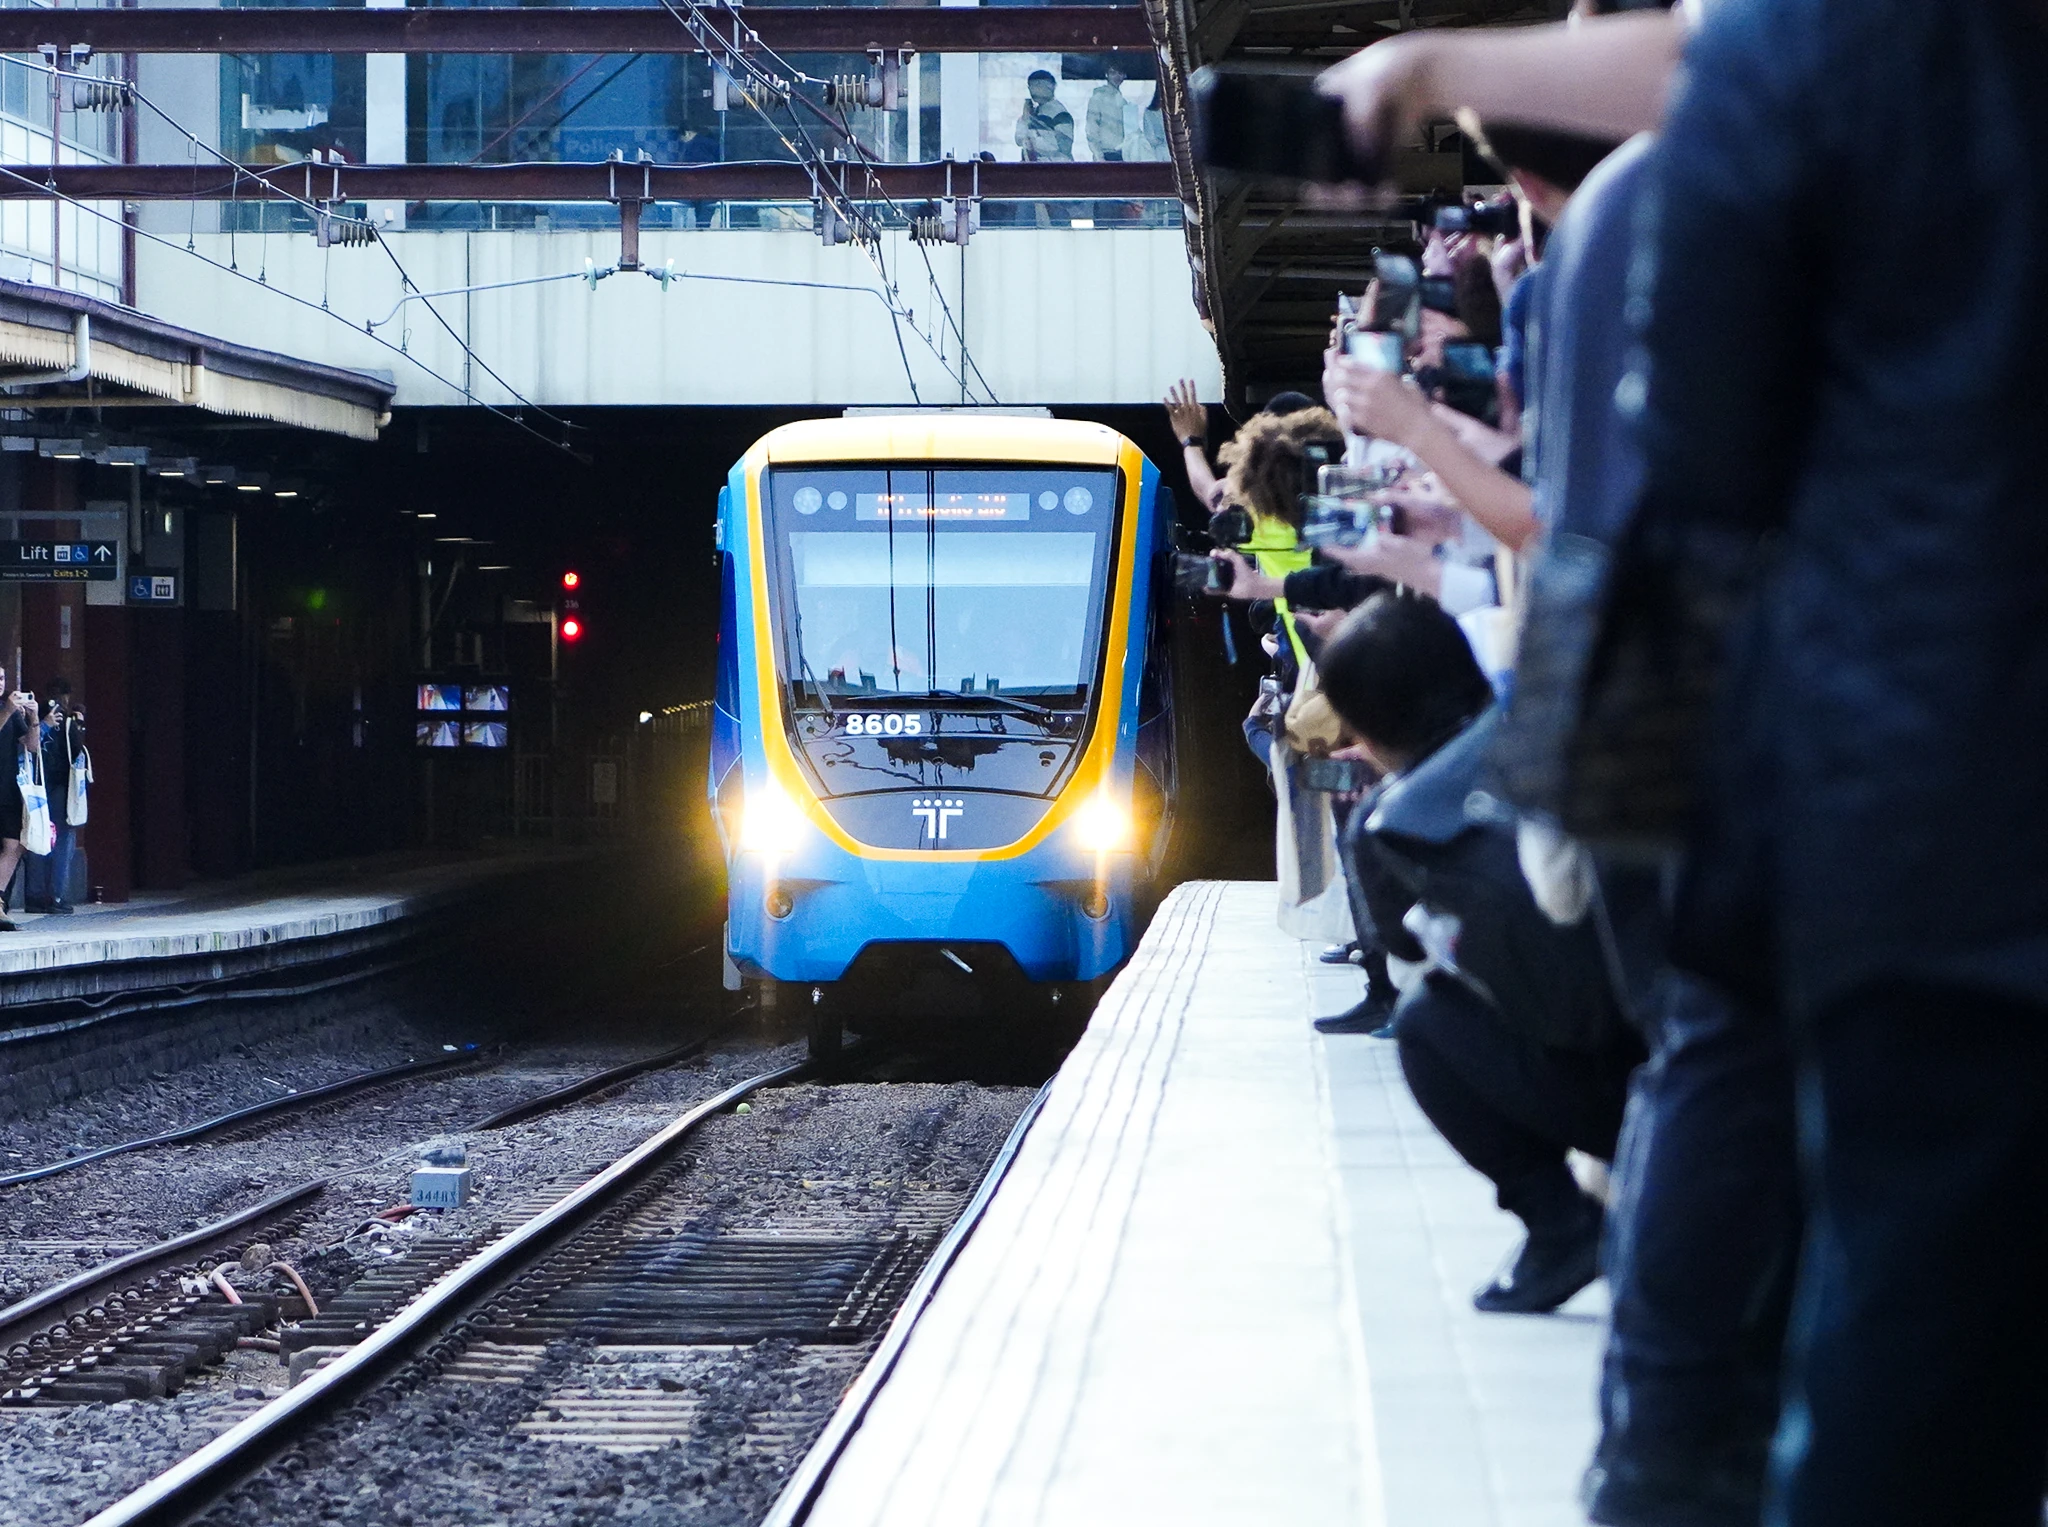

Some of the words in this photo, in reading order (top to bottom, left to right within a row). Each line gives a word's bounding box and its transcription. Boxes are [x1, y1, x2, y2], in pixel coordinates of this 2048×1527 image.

[21, 546, 48, 560] Lift
[53, 569, 74, 578] Exits
[845, 713, 922, 735] 8605
